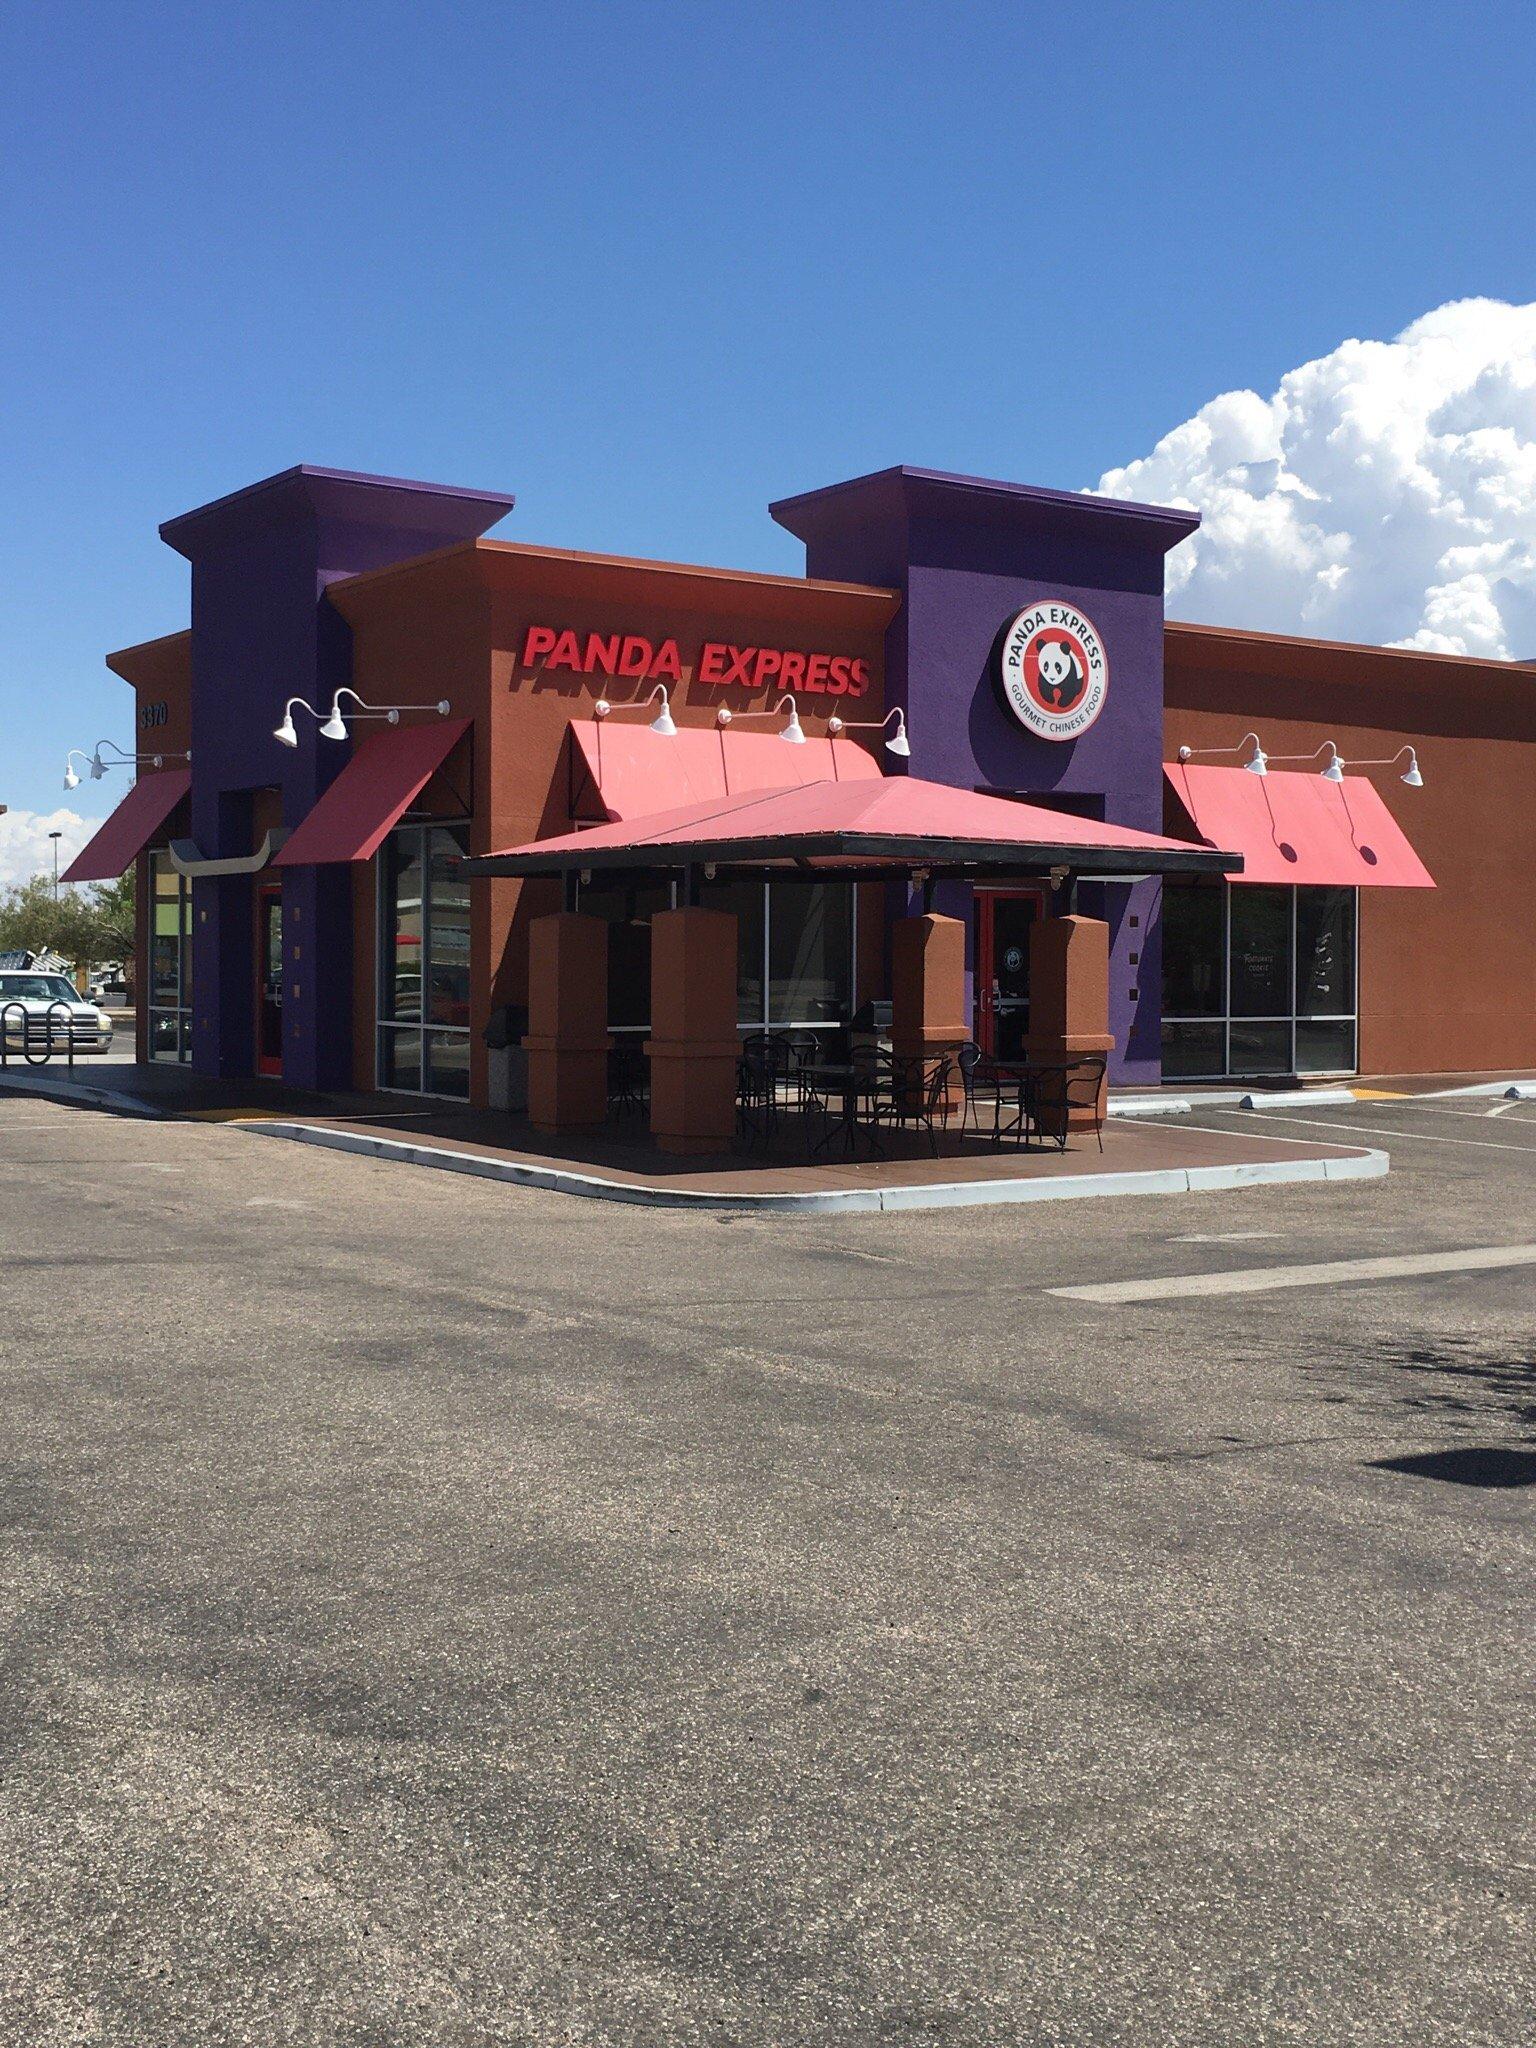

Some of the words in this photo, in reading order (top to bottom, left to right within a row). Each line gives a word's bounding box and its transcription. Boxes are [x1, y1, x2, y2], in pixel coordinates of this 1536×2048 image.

[523, 626, 682, 679] PANDA
[699, 642, 870, 696] EXPRESS
[1009, 611, 1046, 667] PANDA
[1050, 608, 1102, 669] EXPRESS
[140, 702, 167, 729] 3370
[1011, 684, 1046, 728] GOURMET
[1049, 715, 1086, 733] CHINESE
[1085, 686, 1102, 716] FOOD
